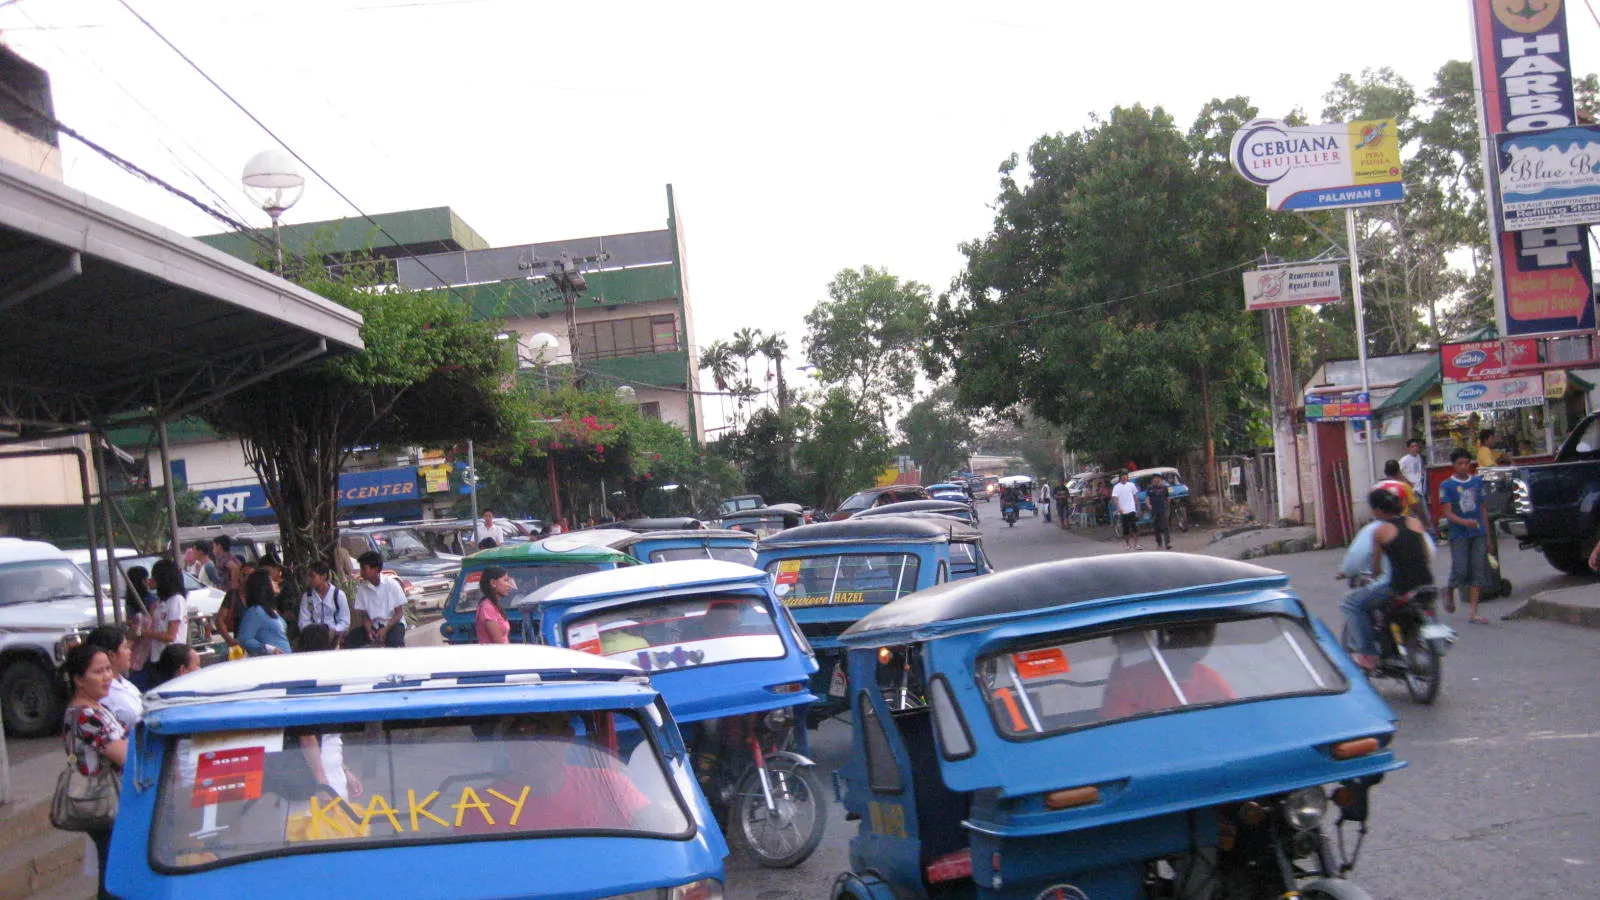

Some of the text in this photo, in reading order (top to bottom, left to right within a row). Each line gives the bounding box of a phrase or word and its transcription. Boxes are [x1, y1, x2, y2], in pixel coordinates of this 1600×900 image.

[1251, 135, 1340, 158] CEBUANA
[1252, 151, 1341, 169] LHUILLIER
[1510, 158, 1566, 183] Blue
[1318, 188, 1382, 203] PALAWAN 5
[1516, 206, 1567, 218] Refilling
[1455, 354, 1483, 365] Buddy
[346, 481, 414, 501] CENTER
[200, 491, 251, 514] ART
[833, 592, 865, 603] HAZEL
[310, 785, 532, 838] KAKAY
